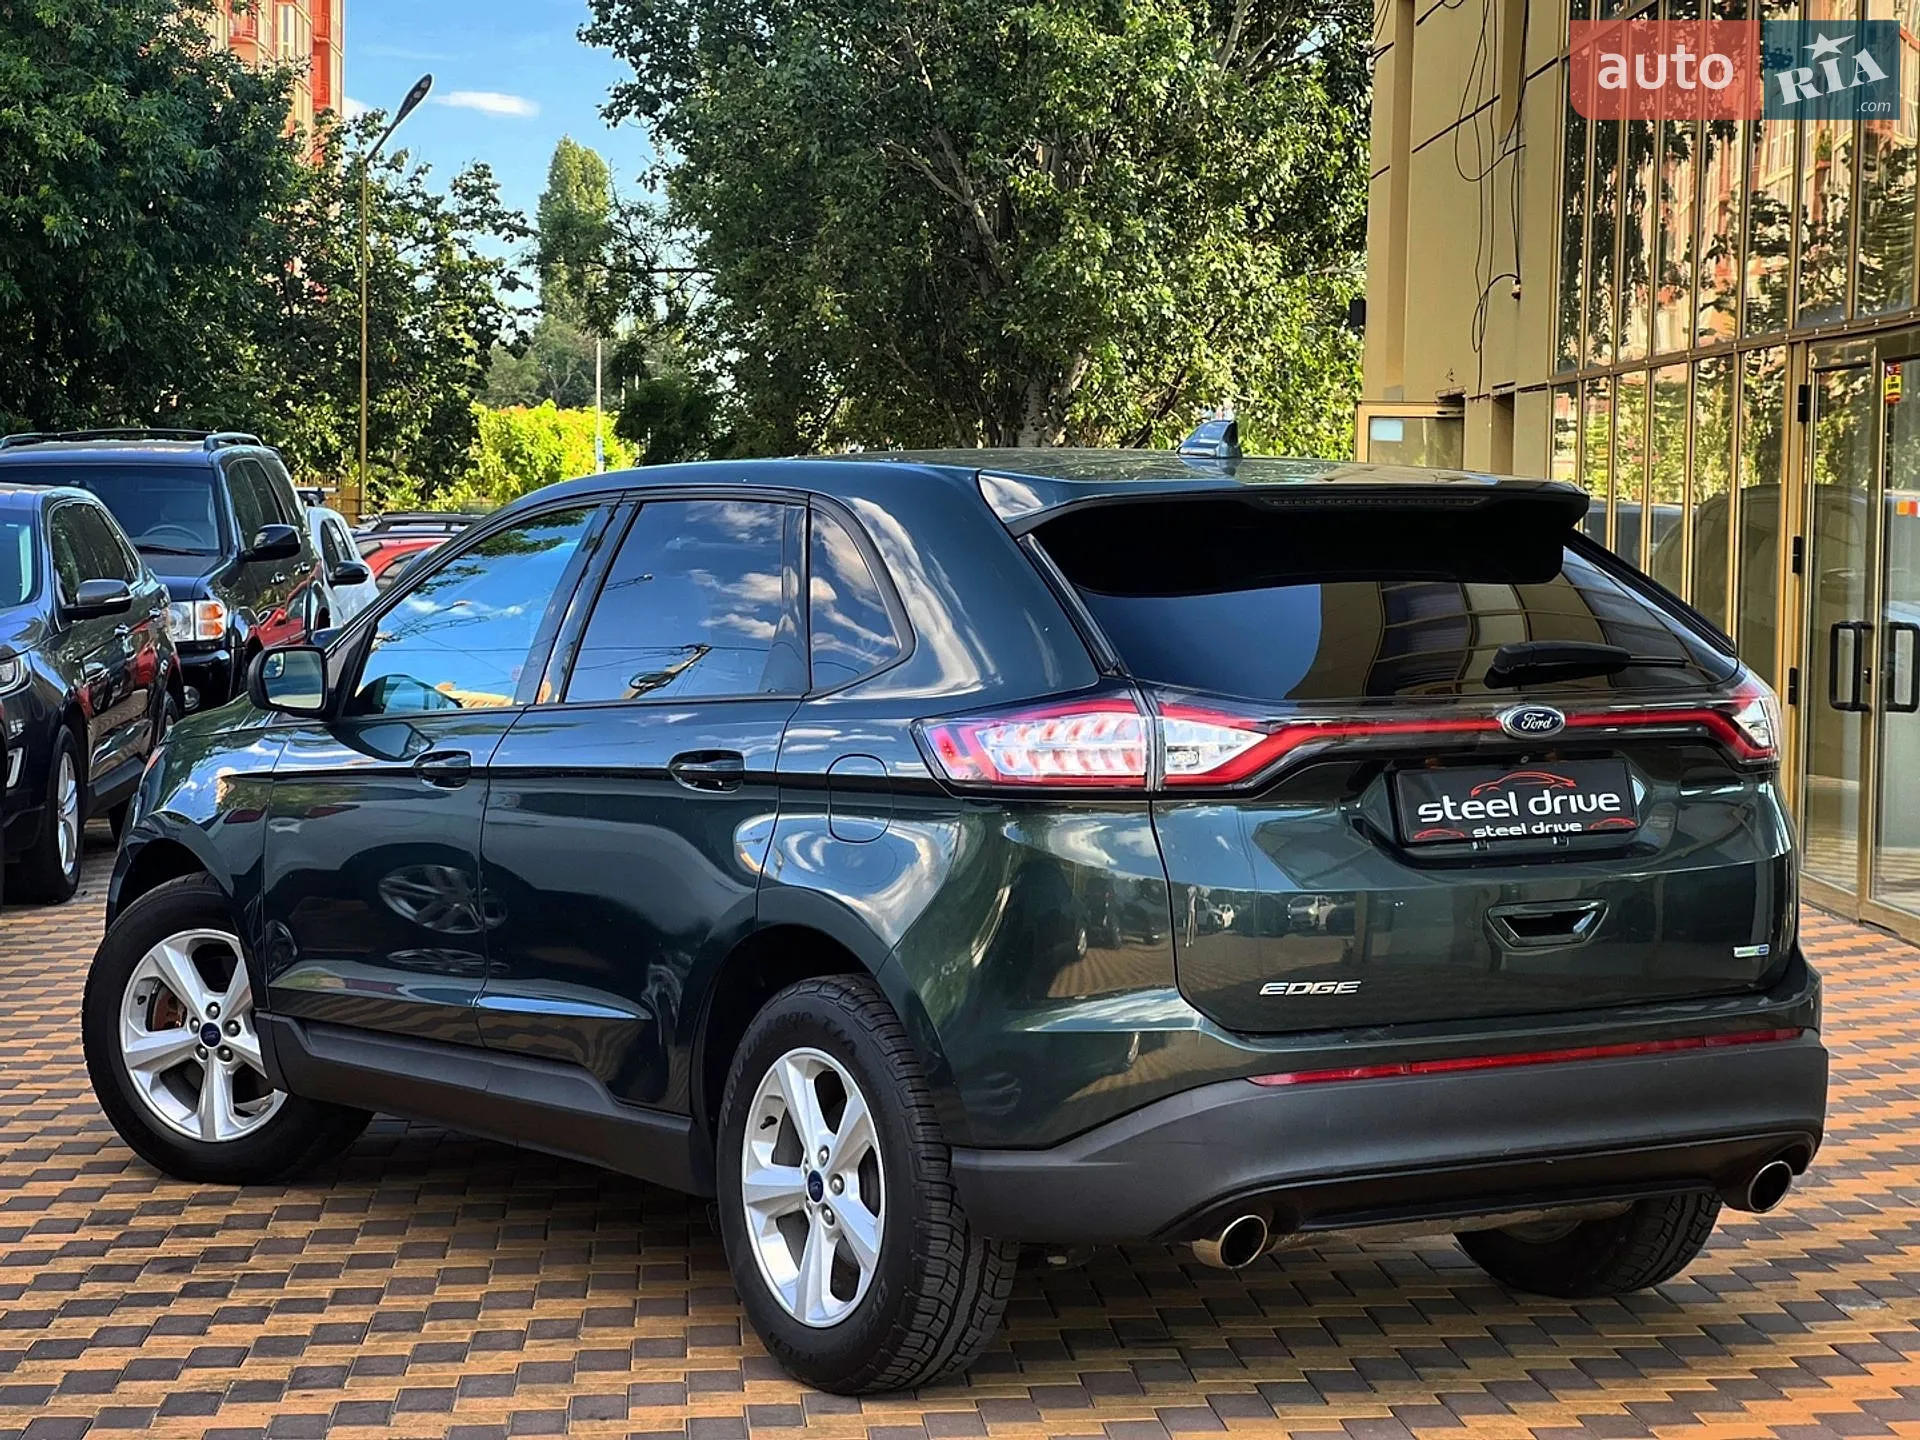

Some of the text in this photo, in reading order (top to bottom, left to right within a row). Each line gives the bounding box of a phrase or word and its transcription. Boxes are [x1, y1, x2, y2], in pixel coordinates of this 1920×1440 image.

[1520, 712, 1553, 730] Ford
[1417, 789, 1621, 823] steel drive
[1472, 821, 1582, 838] steel drive
[1259, 980, 1362, 996] EDGE
